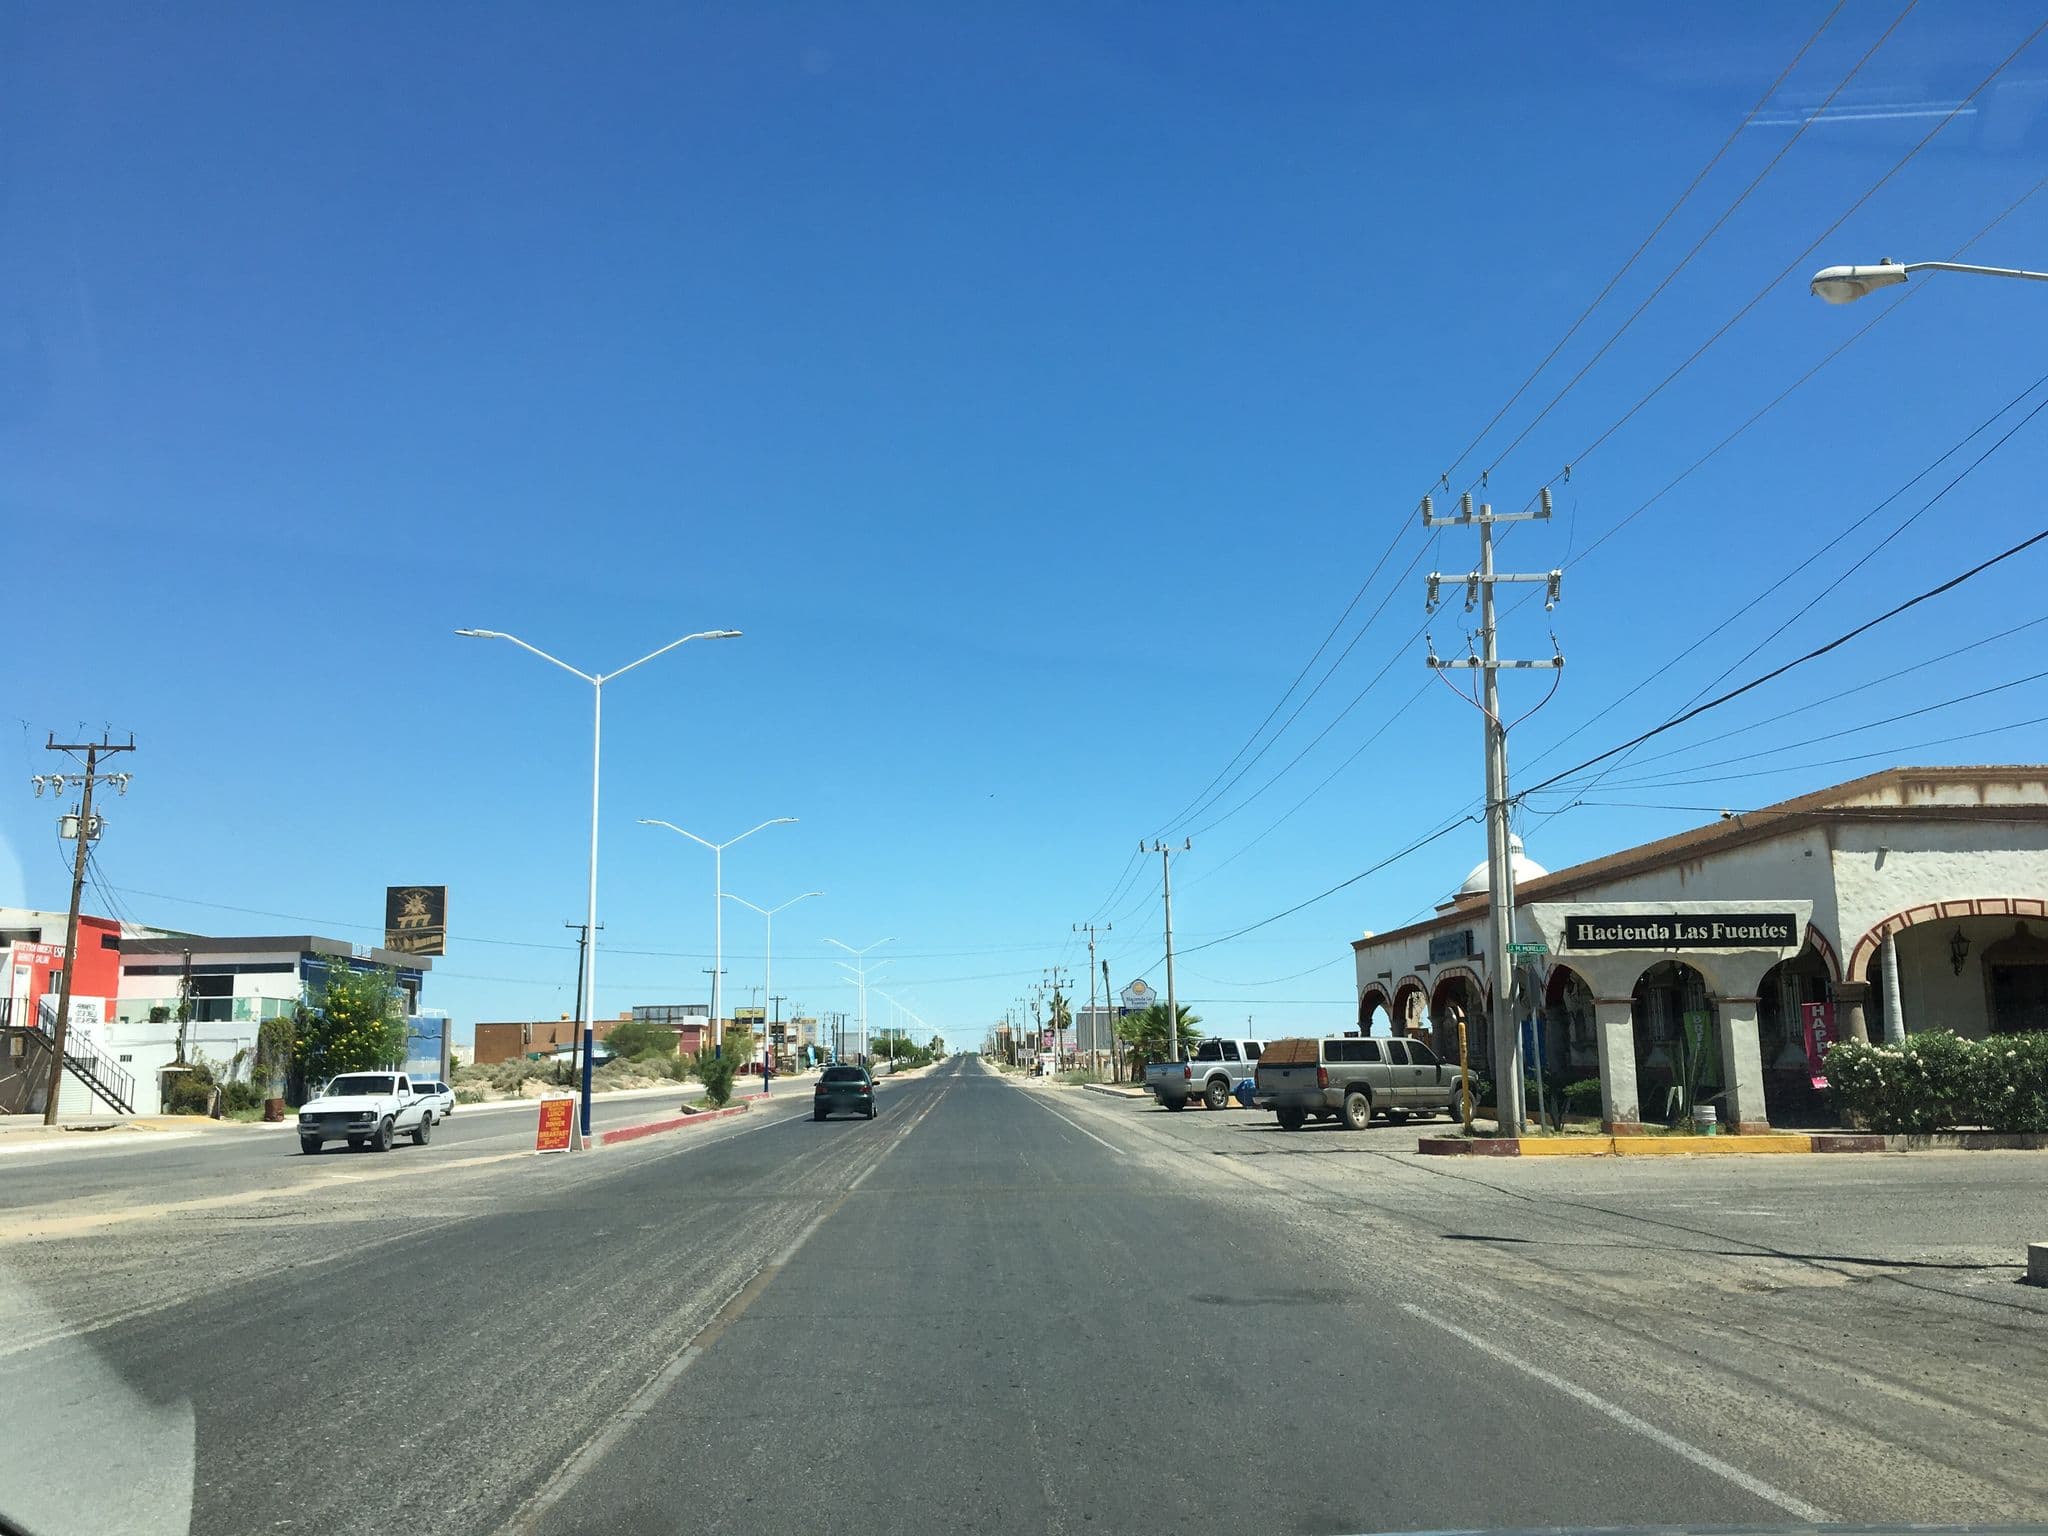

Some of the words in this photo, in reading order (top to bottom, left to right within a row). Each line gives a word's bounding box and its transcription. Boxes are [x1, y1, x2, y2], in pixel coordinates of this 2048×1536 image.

[1576, 923, 1669, 941] Hacienda
[1674, 923, 1708, 940] Las
[1712, 922, 1788, 940] Fuentes
